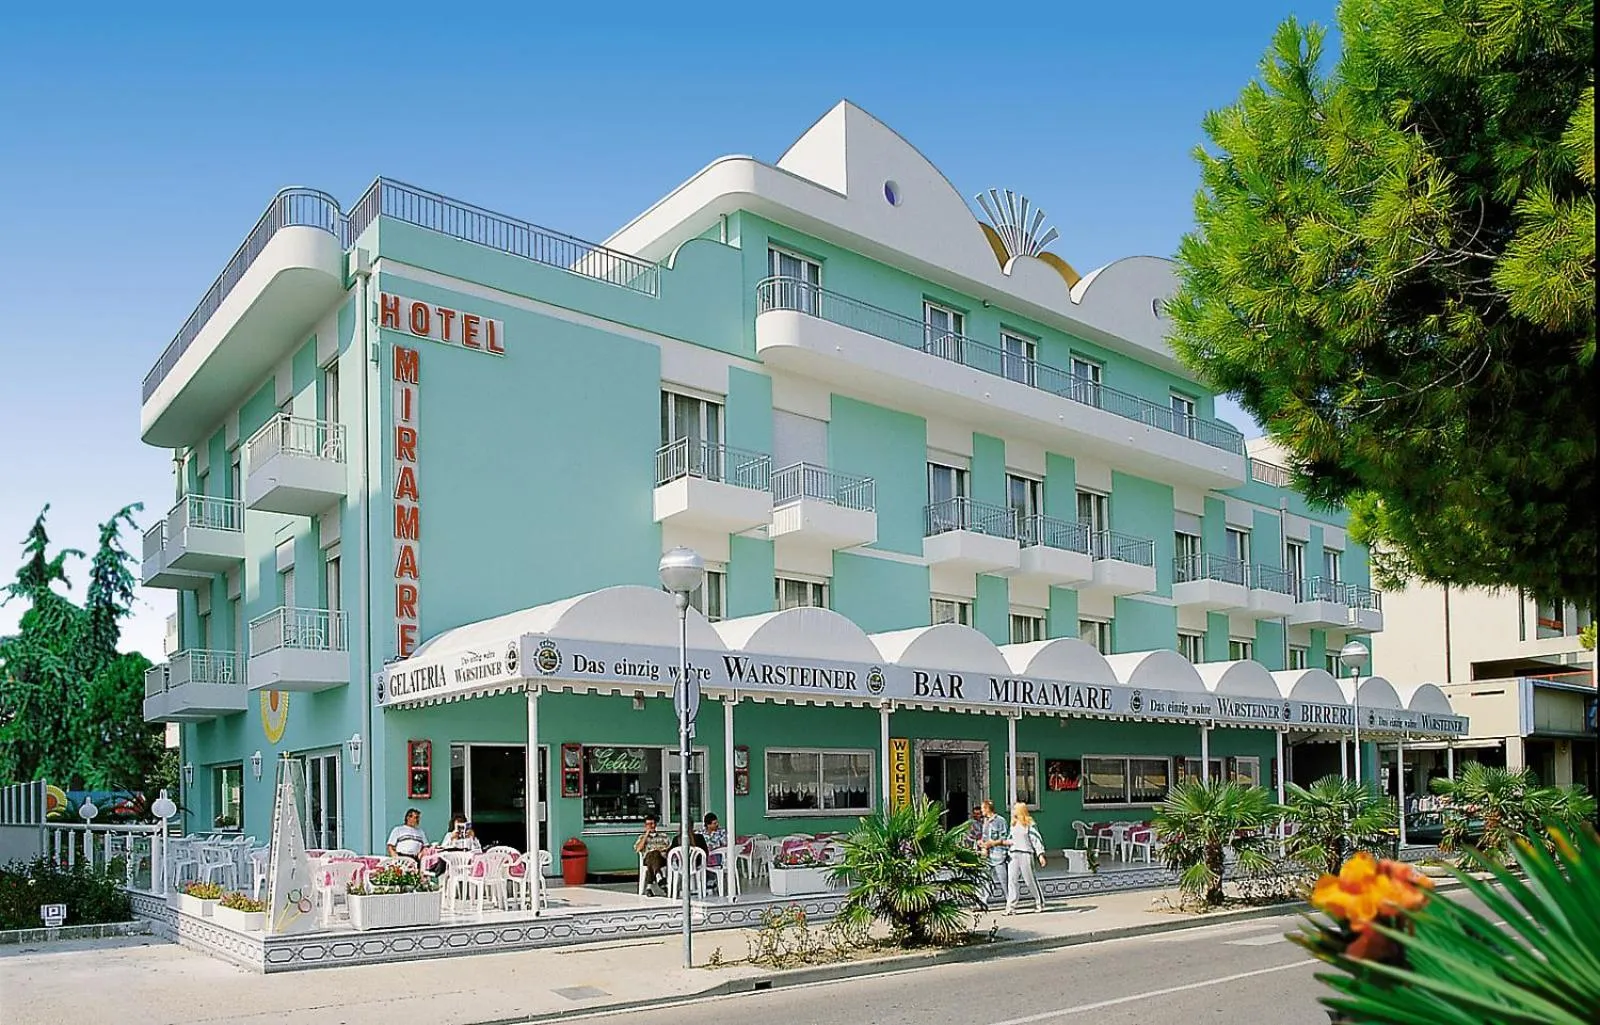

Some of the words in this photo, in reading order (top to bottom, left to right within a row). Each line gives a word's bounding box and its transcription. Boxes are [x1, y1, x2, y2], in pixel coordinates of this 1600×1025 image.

[381, 293, 505, 355] HOTEL
[394, 345, 420, 657] MIRAMARE
[389, 664, 447, 697] GELATERIA
[454, 661, 502, 683] WARSTEINER
[573, 654, 606, 674] Das
[614, 658, 659, 681] einzig
[668, 662, 711, 680] whre
[722, 655, 857, 690] WARSTEINER
[913, 671, 964, 699] BAR
[989, 677, 1113, 710] MIRAMARE
[1150, 699, 1166, 712] Das
[1167, 701, 1189, 716] einzig
[1191, 702, 1212, 715] wahre
[1216, 697, 1280, 719] WARSTEINER
[1421, 713, 1463, 732] WARSTEINER
